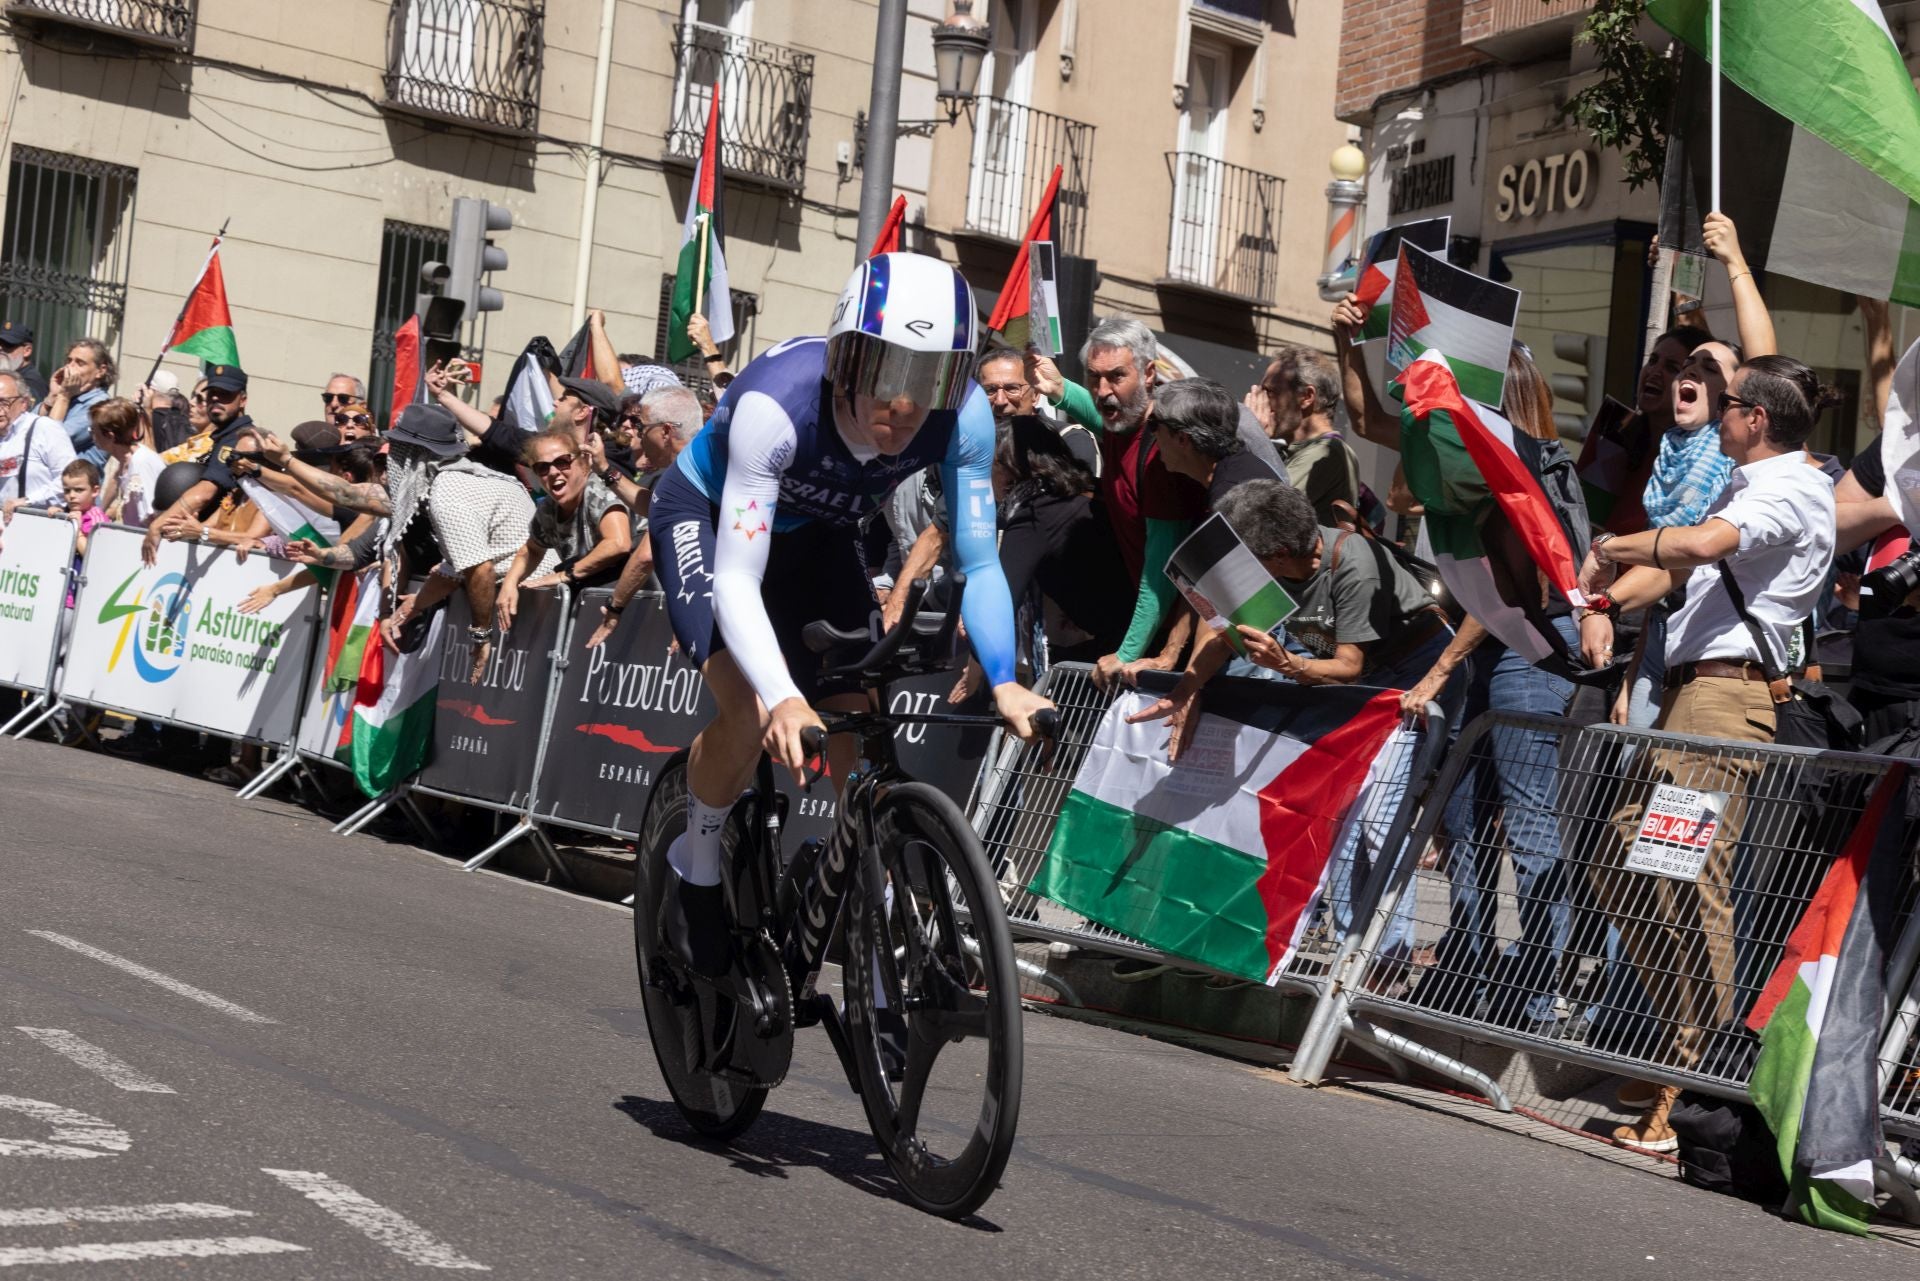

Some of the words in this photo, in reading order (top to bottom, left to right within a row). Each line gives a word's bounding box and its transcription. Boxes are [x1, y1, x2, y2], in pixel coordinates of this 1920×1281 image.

[1495, 149, 1590, 222] SOTO
[781, 477, 864, 514] SRAEL
[672, 521, 705, 577] ISRAEL
[195, 597, 285, 648] Asturias
[190, 641, 234, 665] paraíso
[235, 649, 278, 674] natural
[450, 735, 488, 755] ESPAÑA
[599, 763, 650, 786] ESPAÑA
[799, 798, 836, 819] ESPA
[1656, 788, 1698, 806] ALQUILER
[1661, 803, 1685, 816] EQUIPOS
[870, 908, 885, 957] ACTOR
